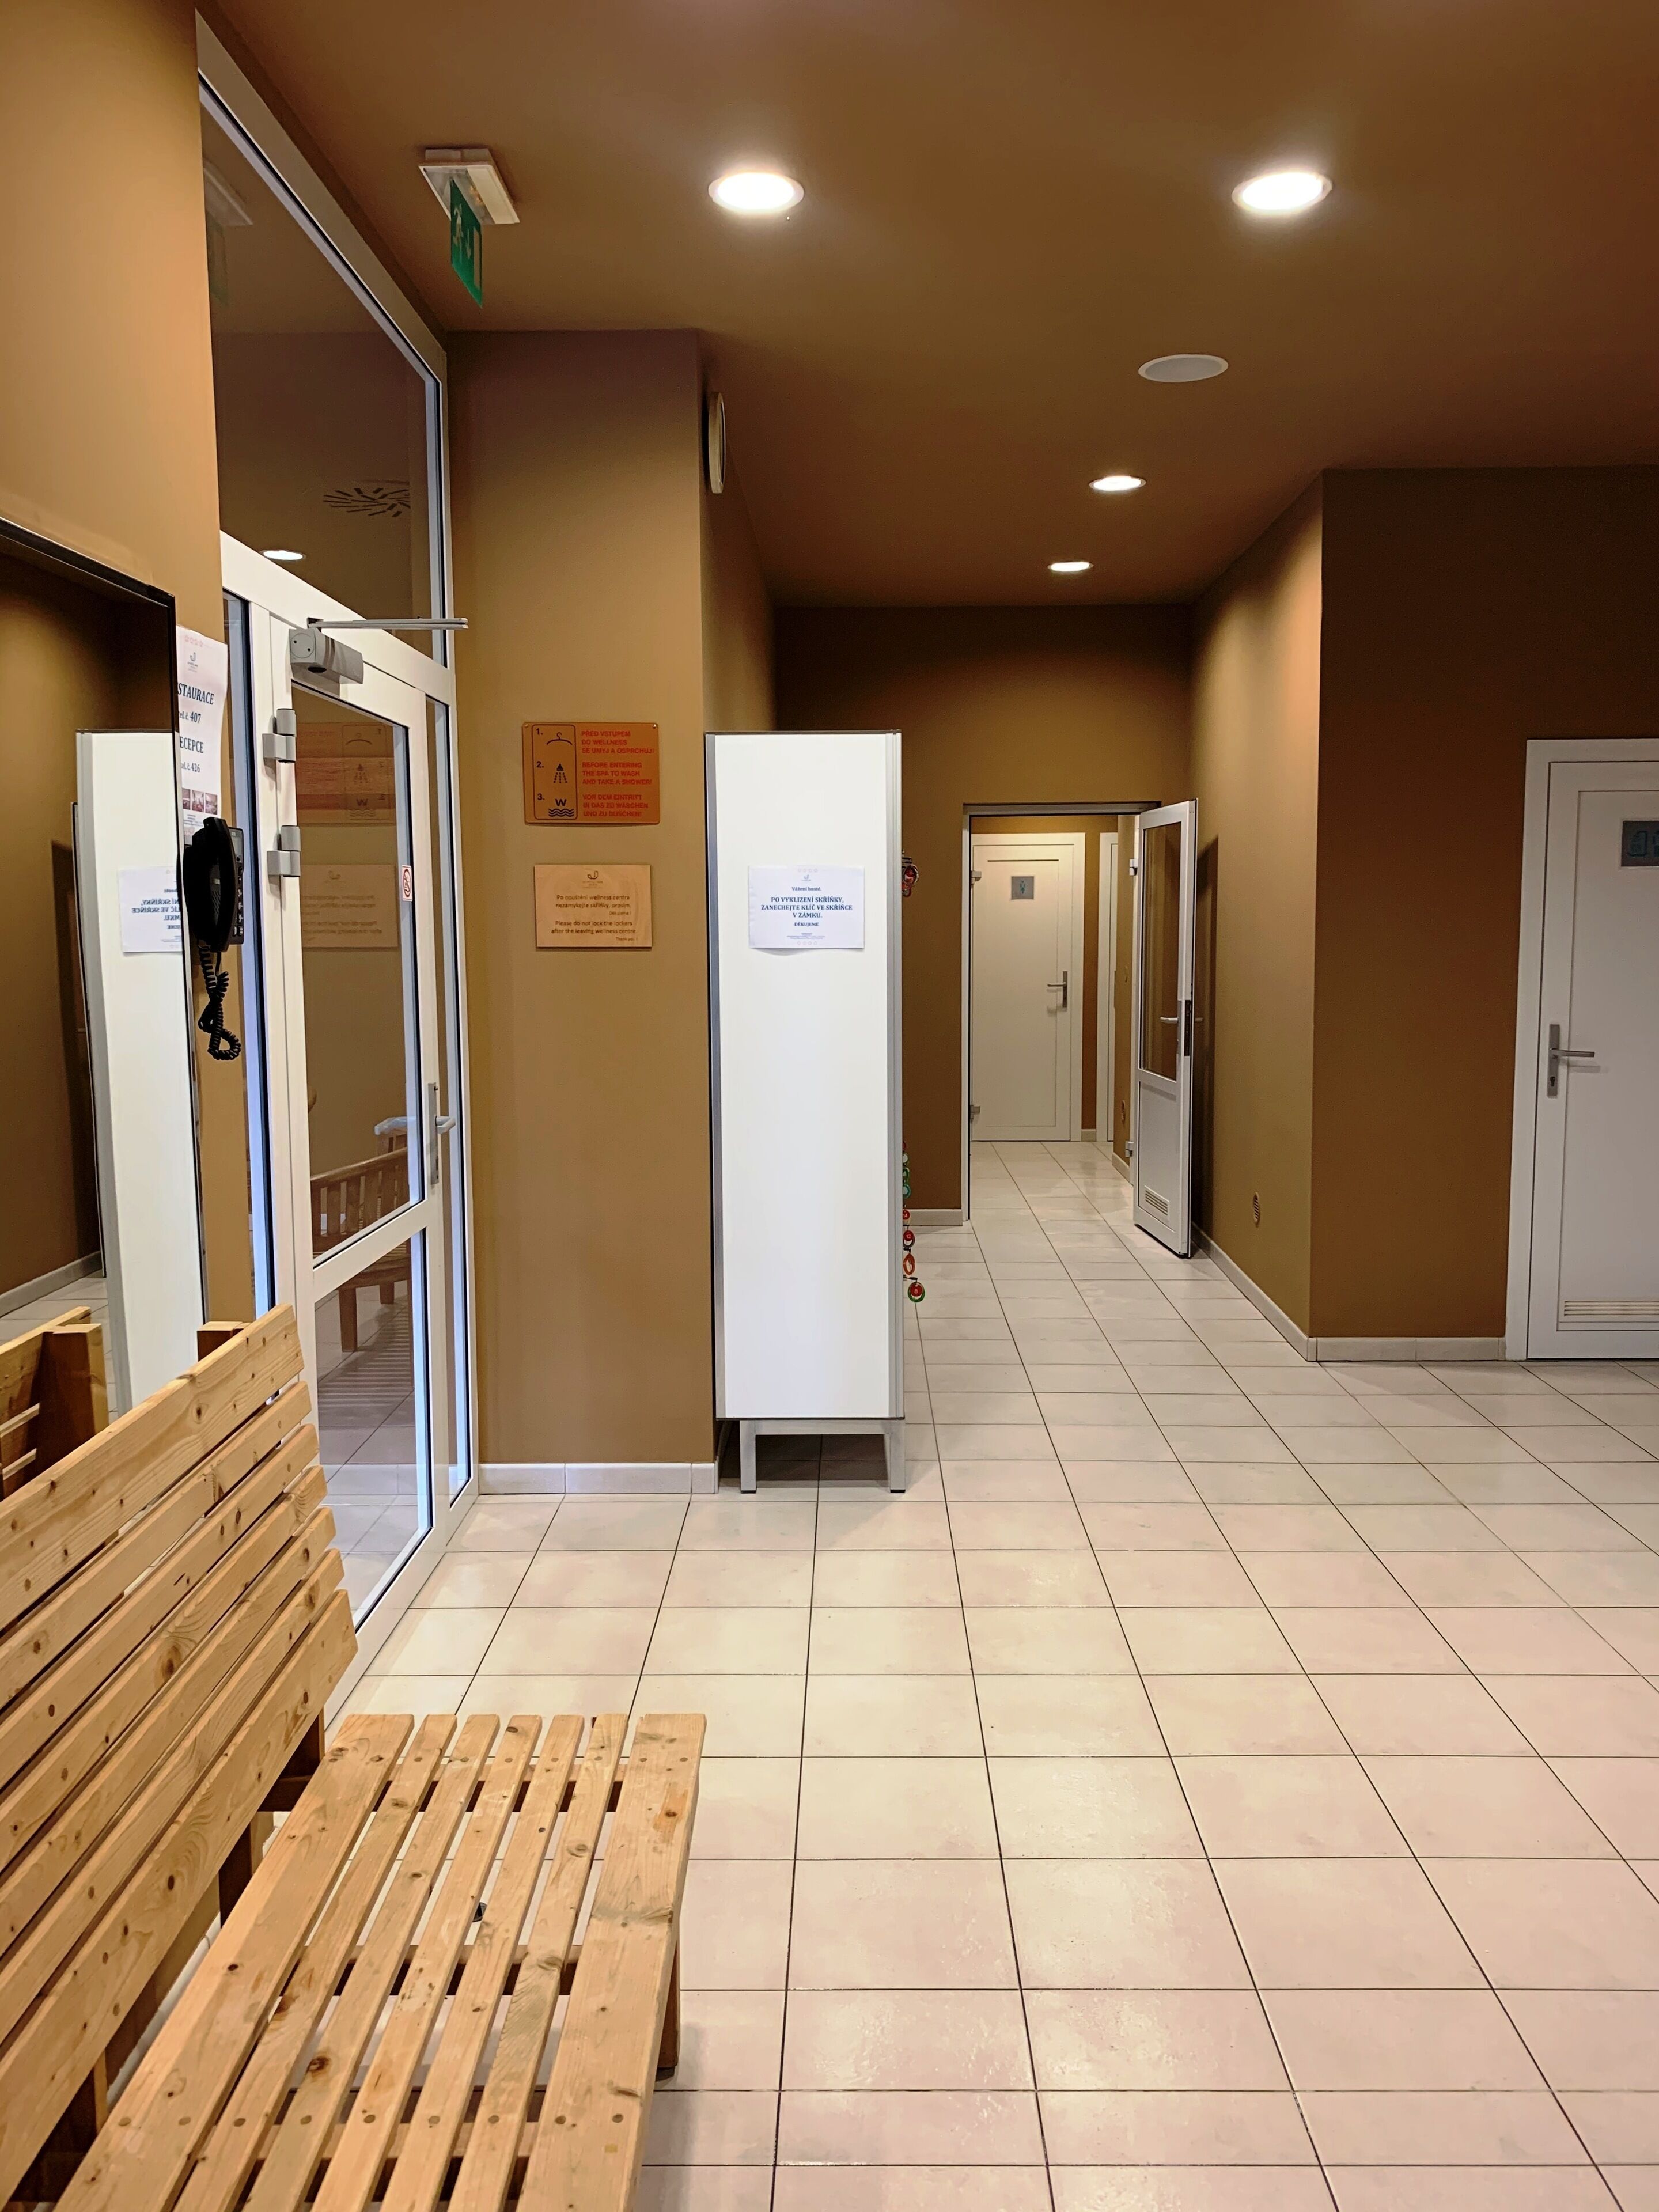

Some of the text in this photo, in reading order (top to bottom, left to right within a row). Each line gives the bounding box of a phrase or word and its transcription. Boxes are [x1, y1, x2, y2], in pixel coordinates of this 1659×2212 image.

[178, 683, 214, 705] STAURACE
[190, 711, 202, 724] 407
[180, 736, 204, 753] ECEPCE
[191, 763, 200, 773] 426
[536, 760, 544, 768] 2.
[555, 798, 567, 806] W
[815, 896, 844, 904] SKŘÍŇKY,
